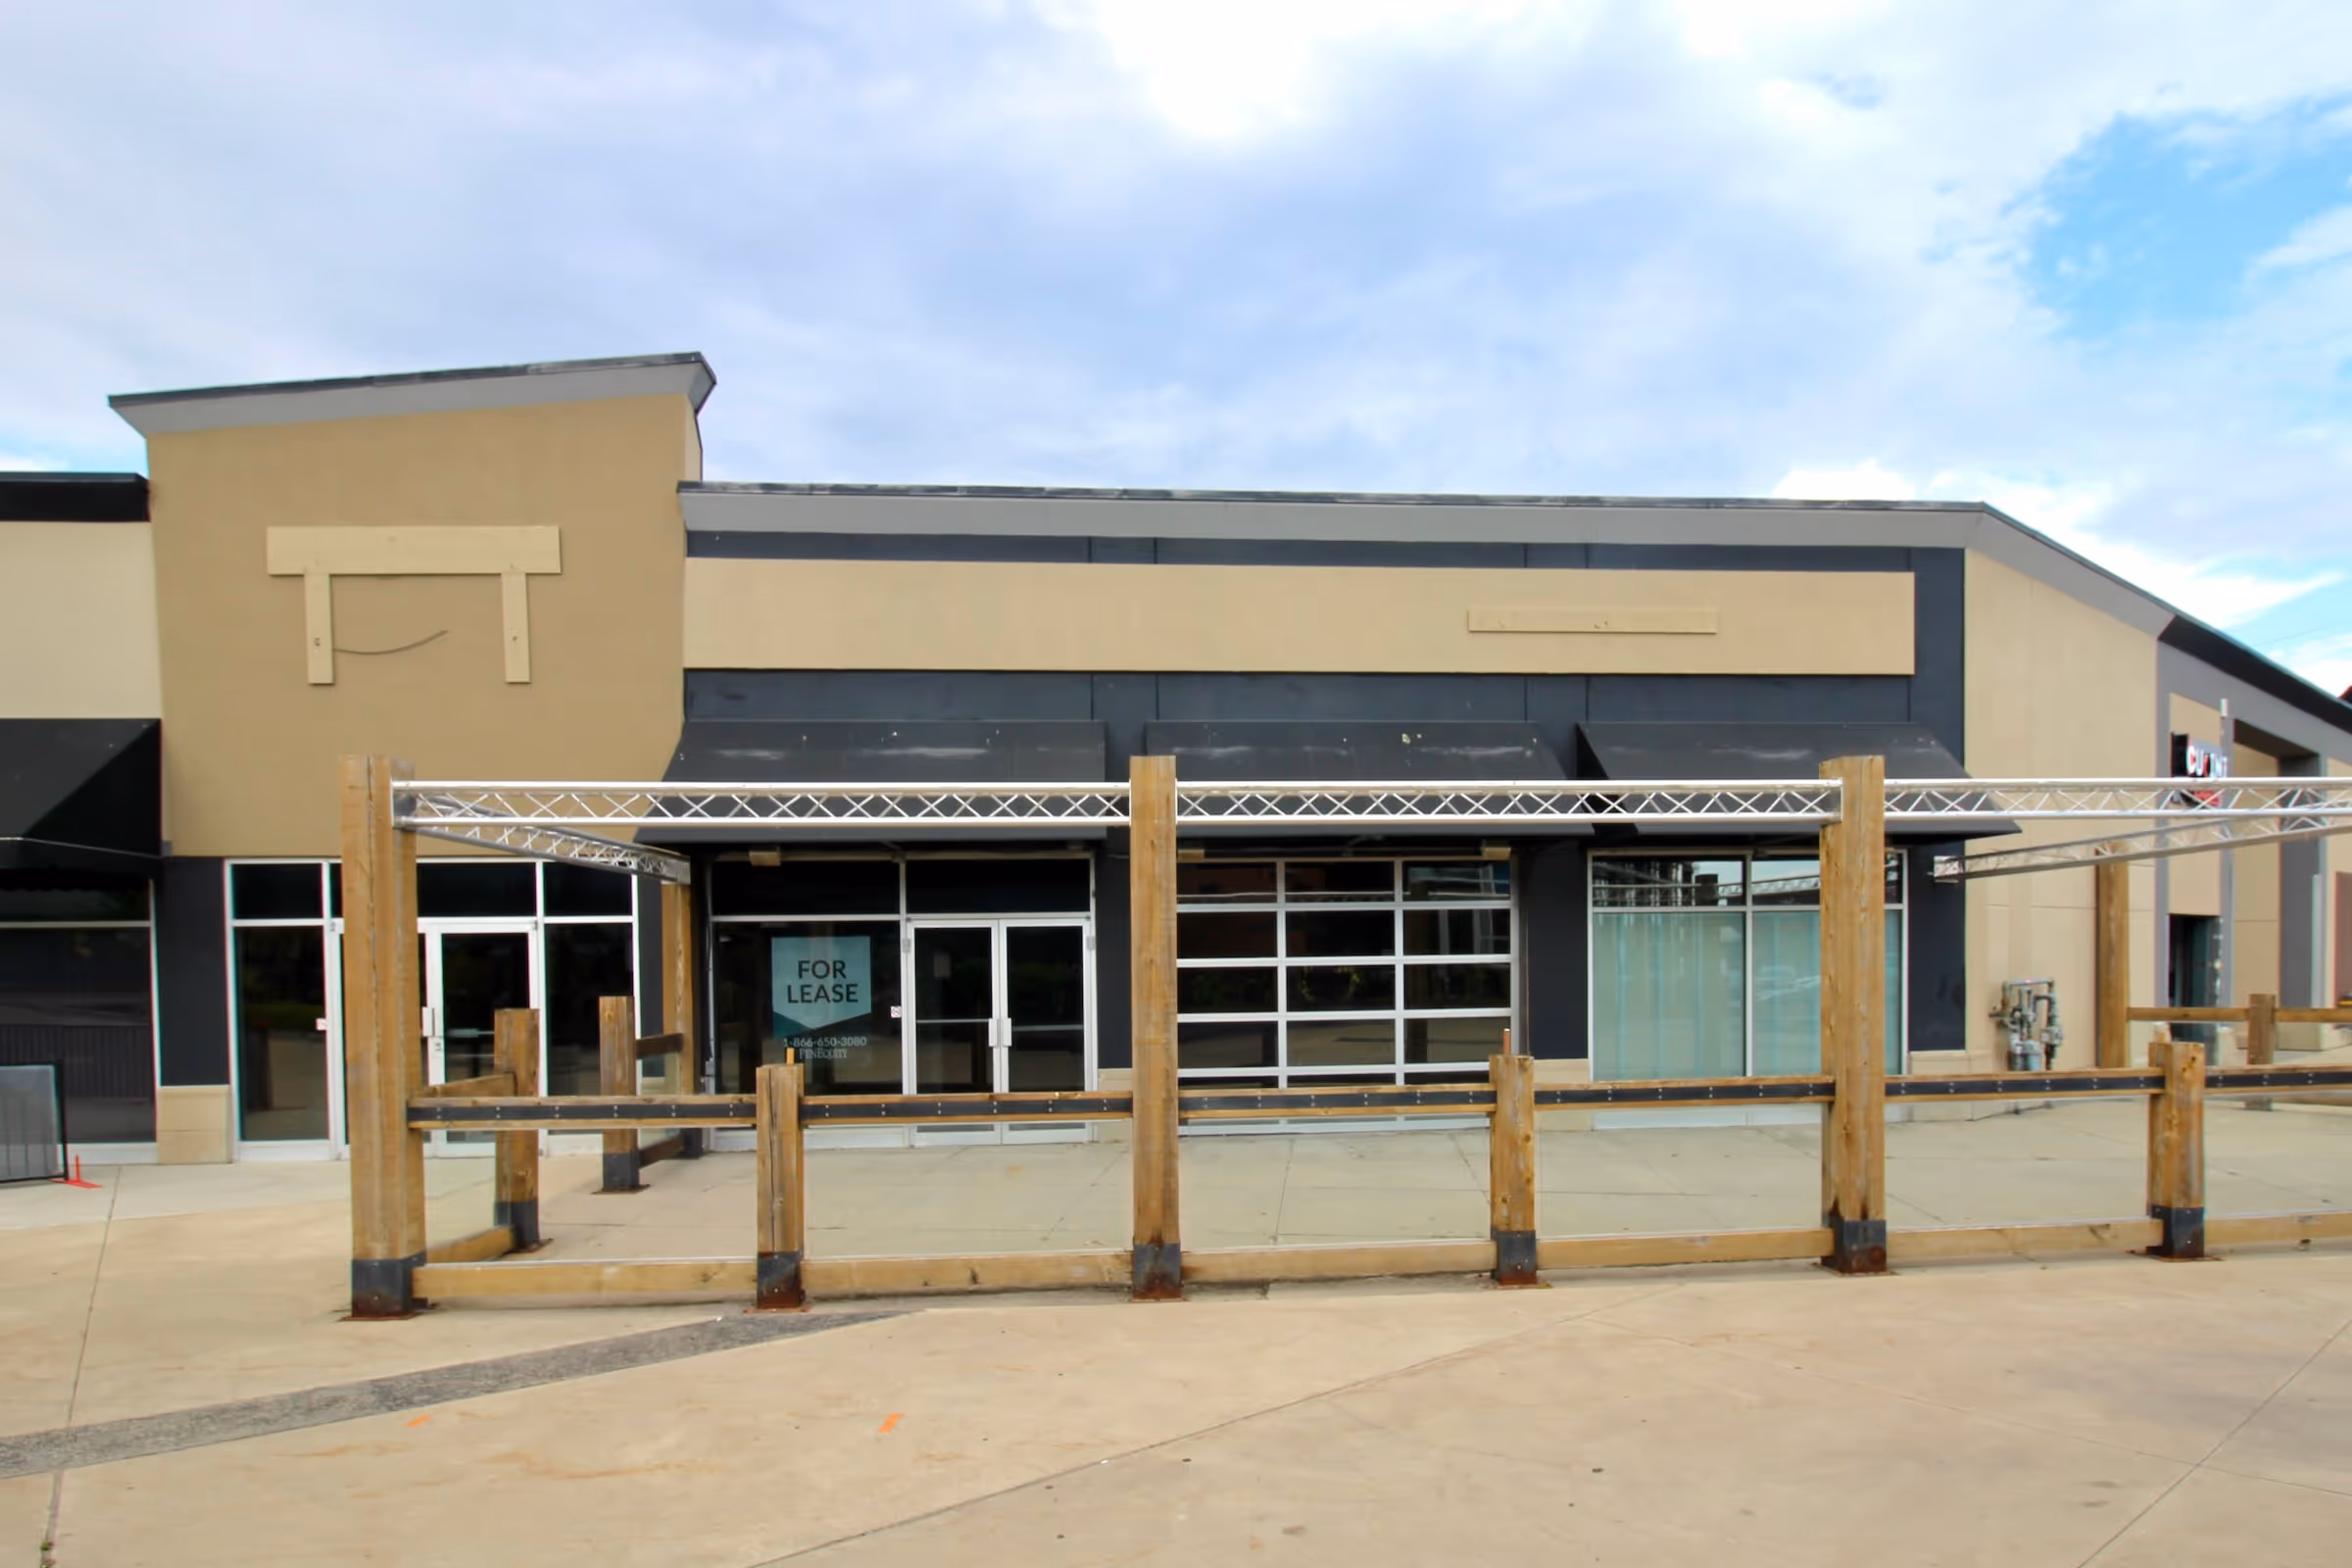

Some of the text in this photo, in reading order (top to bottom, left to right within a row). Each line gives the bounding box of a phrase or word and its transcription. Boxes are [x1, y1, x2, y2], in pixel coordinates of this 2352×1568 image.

[798, 959, 847, 979] FOR
[787, 983, 858, 1004] LEASE
[783, 1036, 867, 1048] 1-866-650-3080
